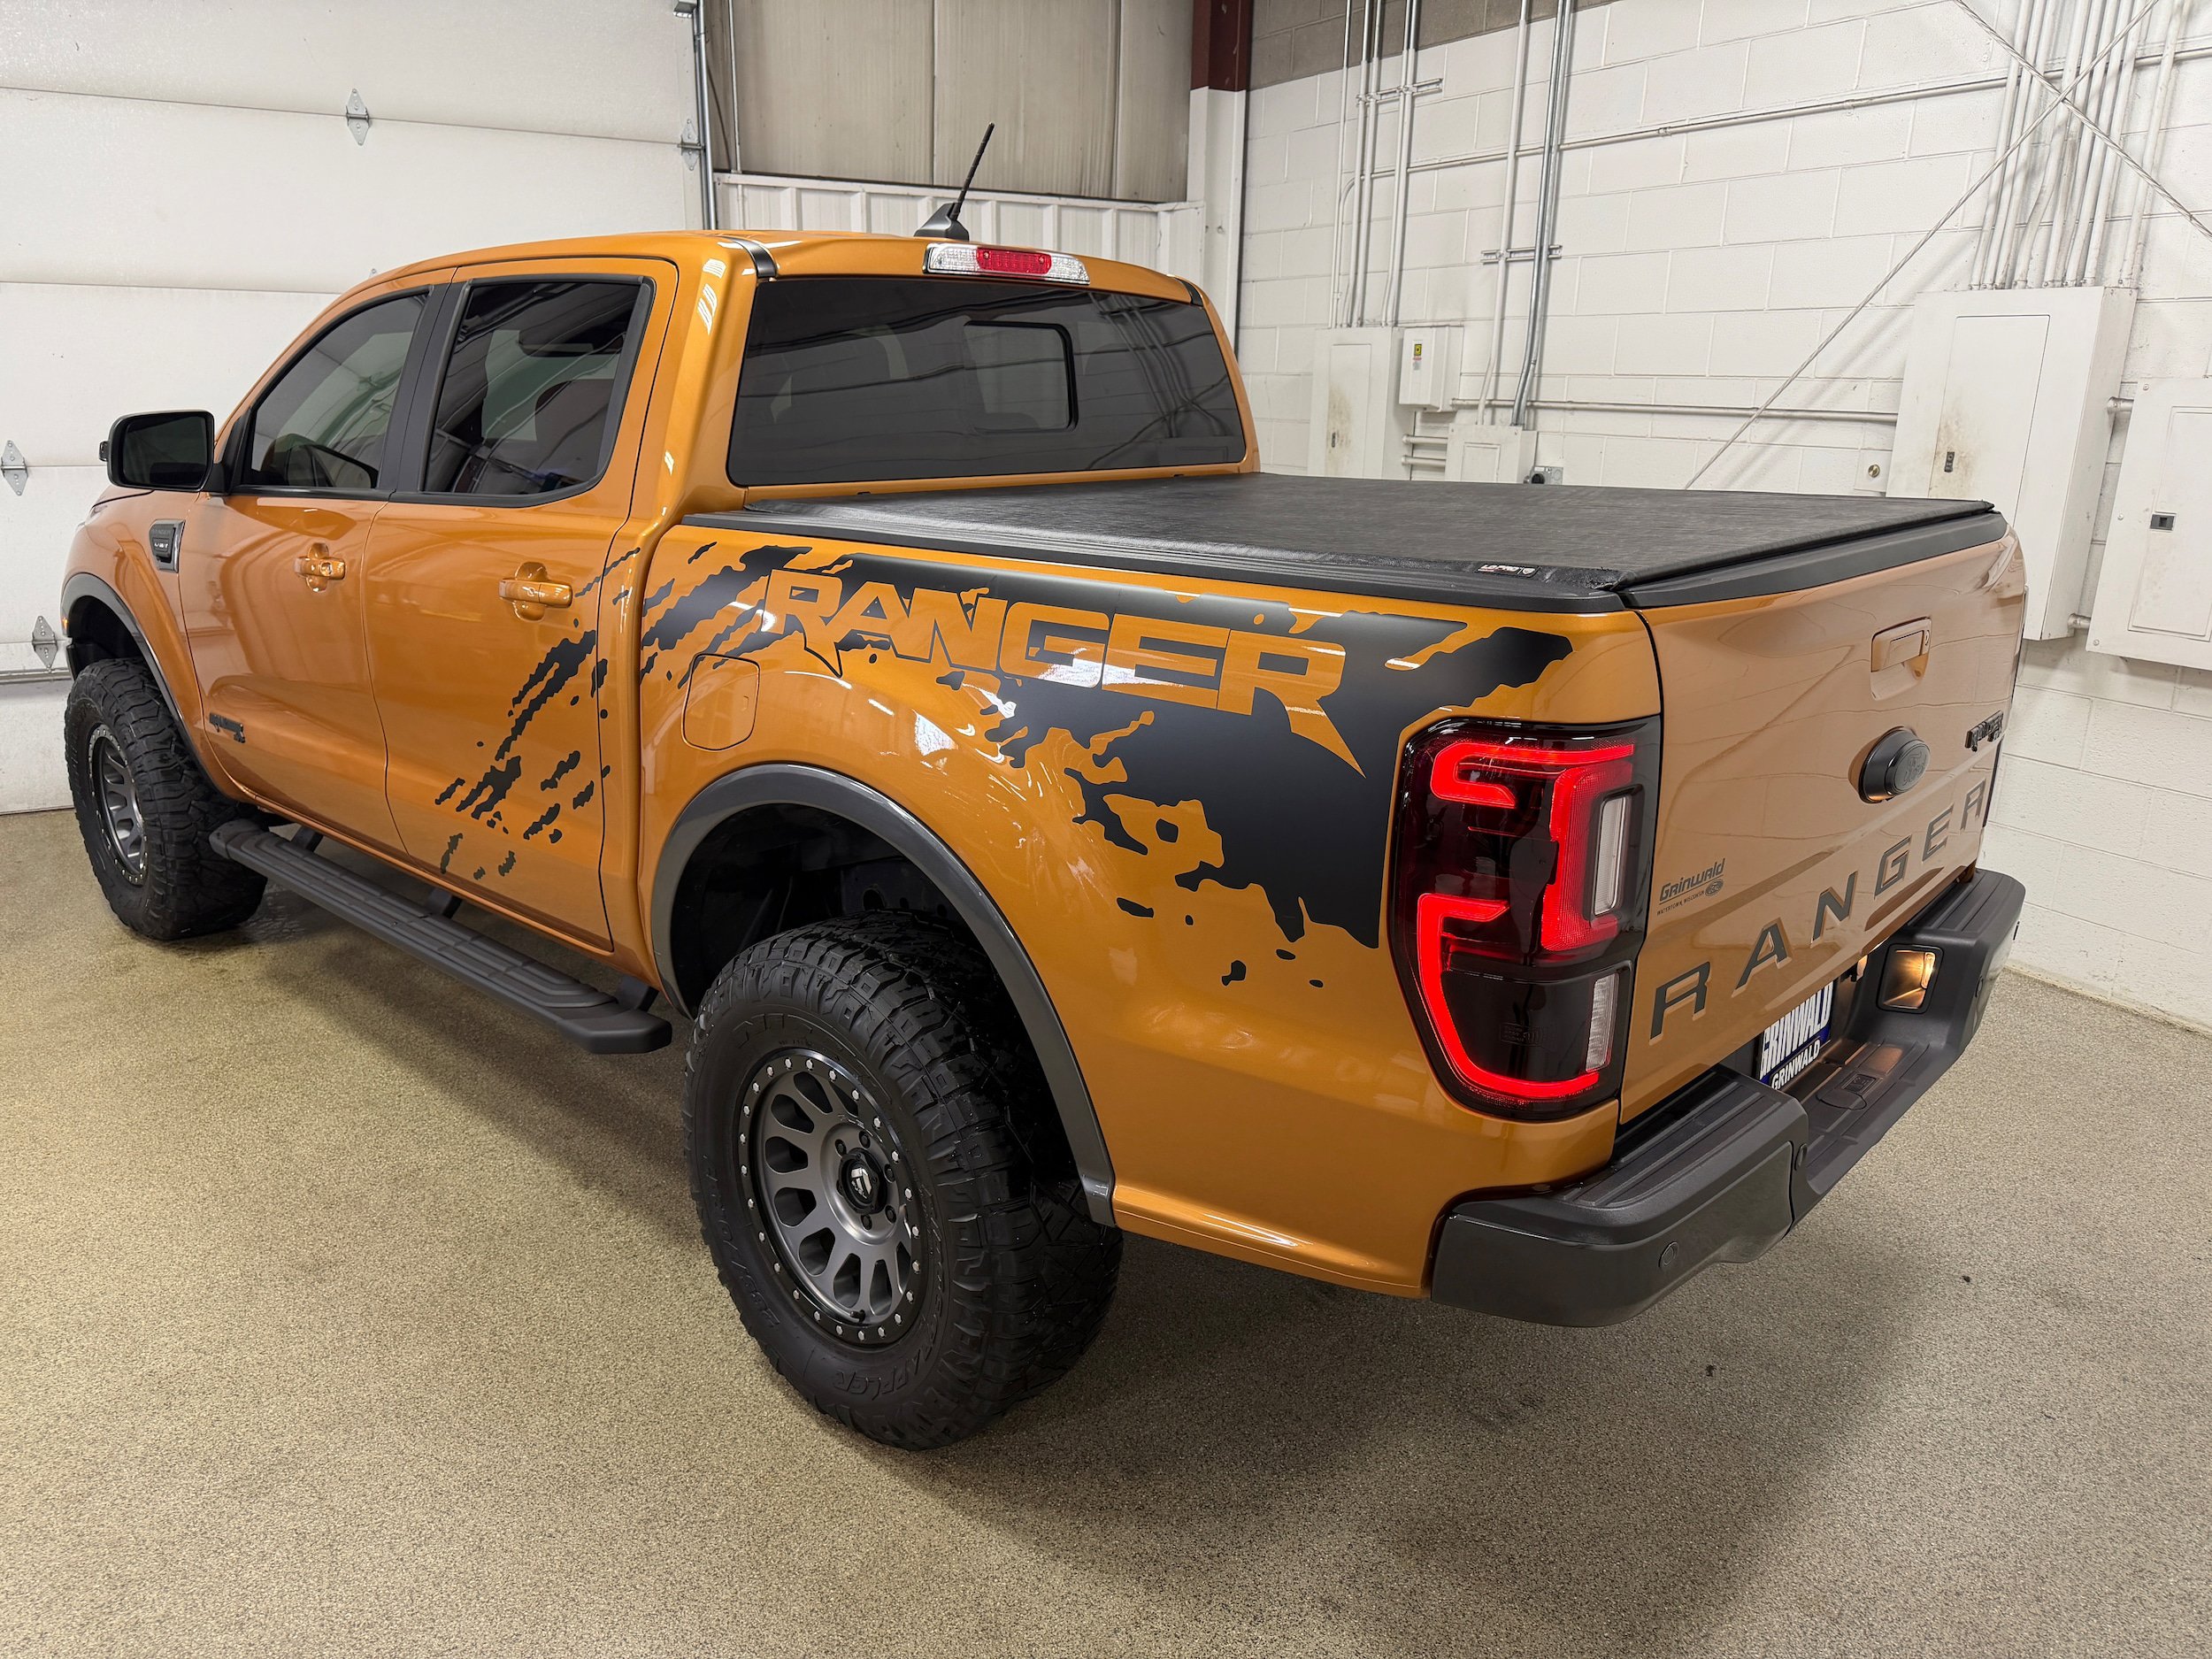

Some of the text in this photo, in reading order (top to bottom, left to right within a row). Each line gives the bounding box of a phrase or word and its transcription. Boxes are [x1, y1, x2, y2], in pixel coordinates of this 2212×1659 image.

[762, 568, 1366, 779] RANGER
[1649, 779, 1985, 1042] RANGER
[1760, 980, 1833, 1080] GRINWALD
[1771, 1039, 1821, 1090] GRINWALD
